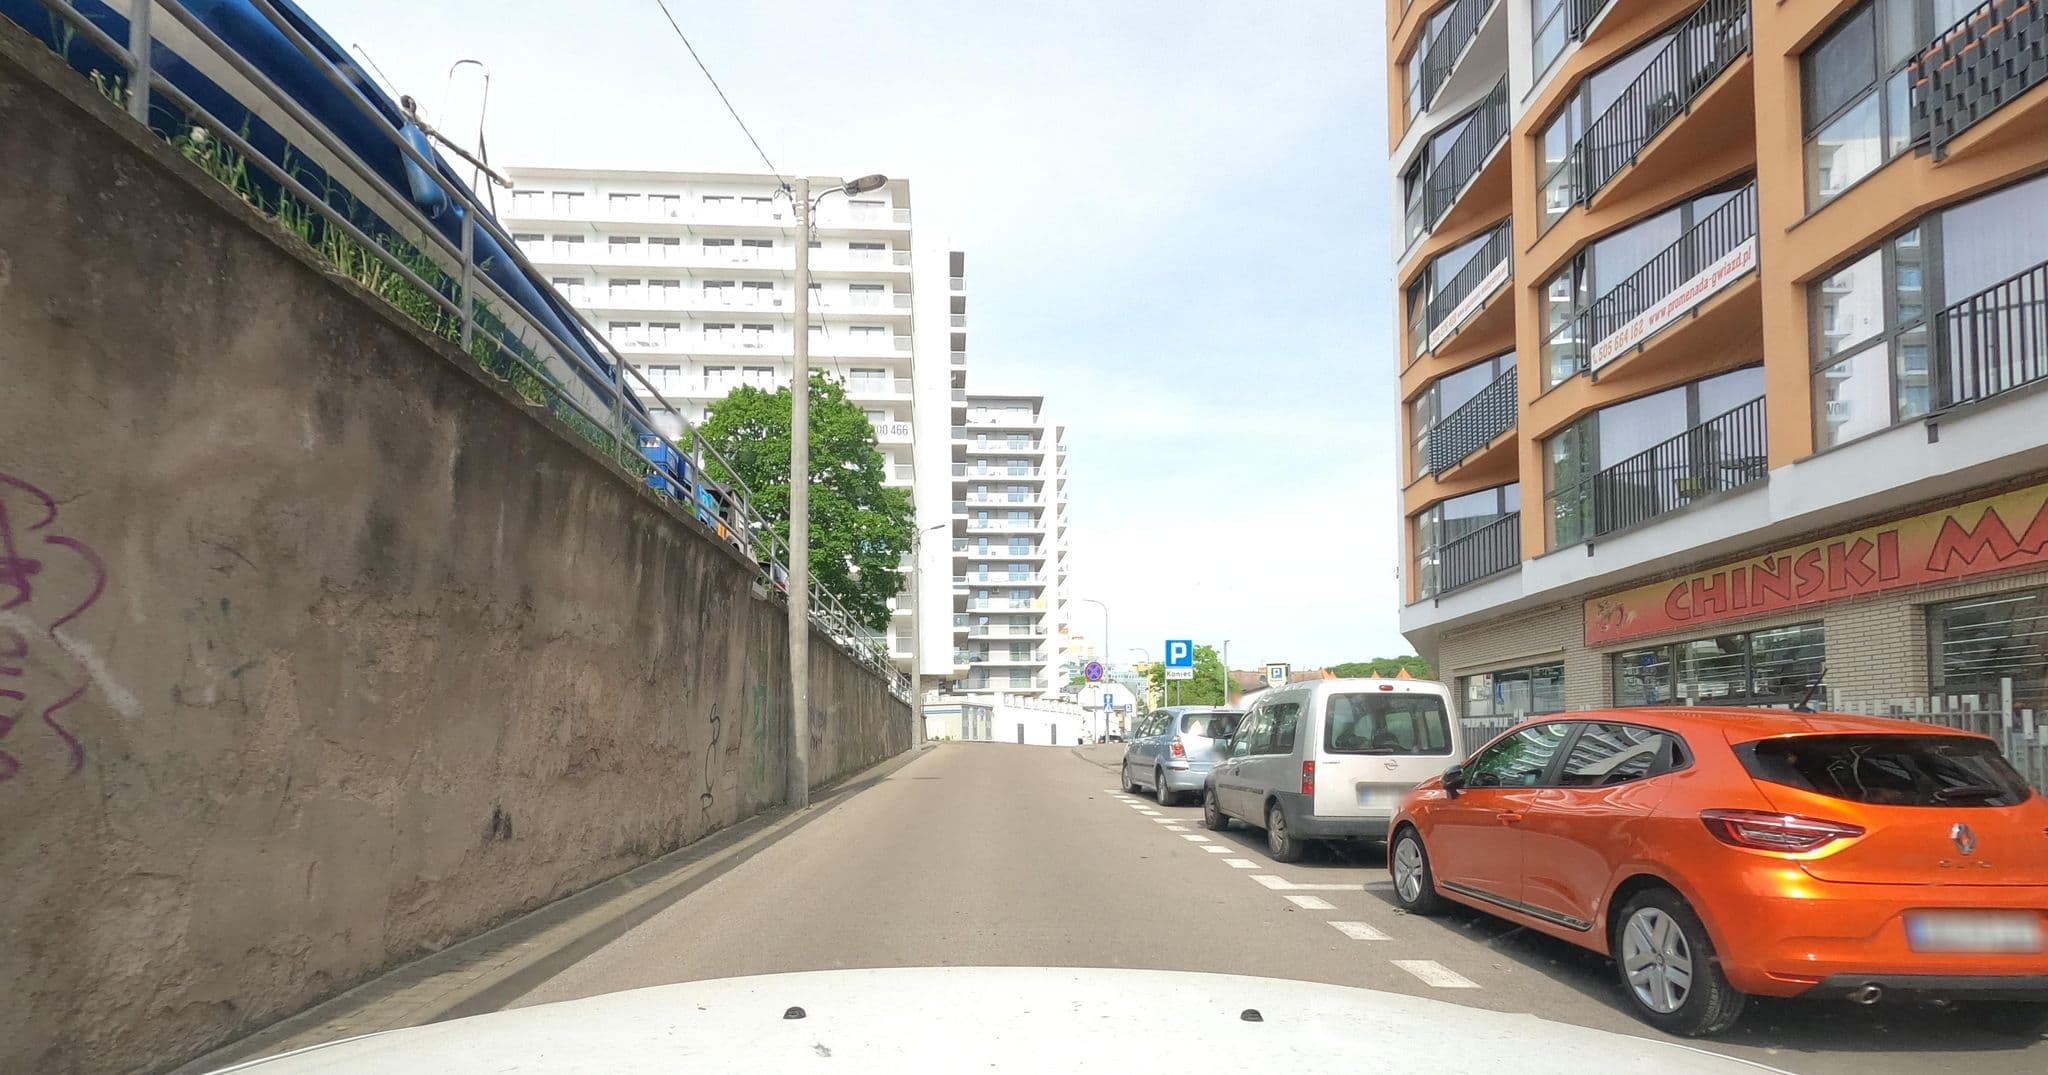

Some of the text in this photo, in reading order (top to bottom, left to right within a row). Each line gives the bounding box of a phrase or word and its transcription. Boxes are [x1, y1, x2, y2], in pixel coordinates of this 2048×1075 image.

[1649, 245, 1752, 326] www.promenada-gwiazd.pl
[890, 424, 908, 436] 466
[1664, 529, 1900, 622] CHIŃSKI
[1171, 642, 1187, 665] P
